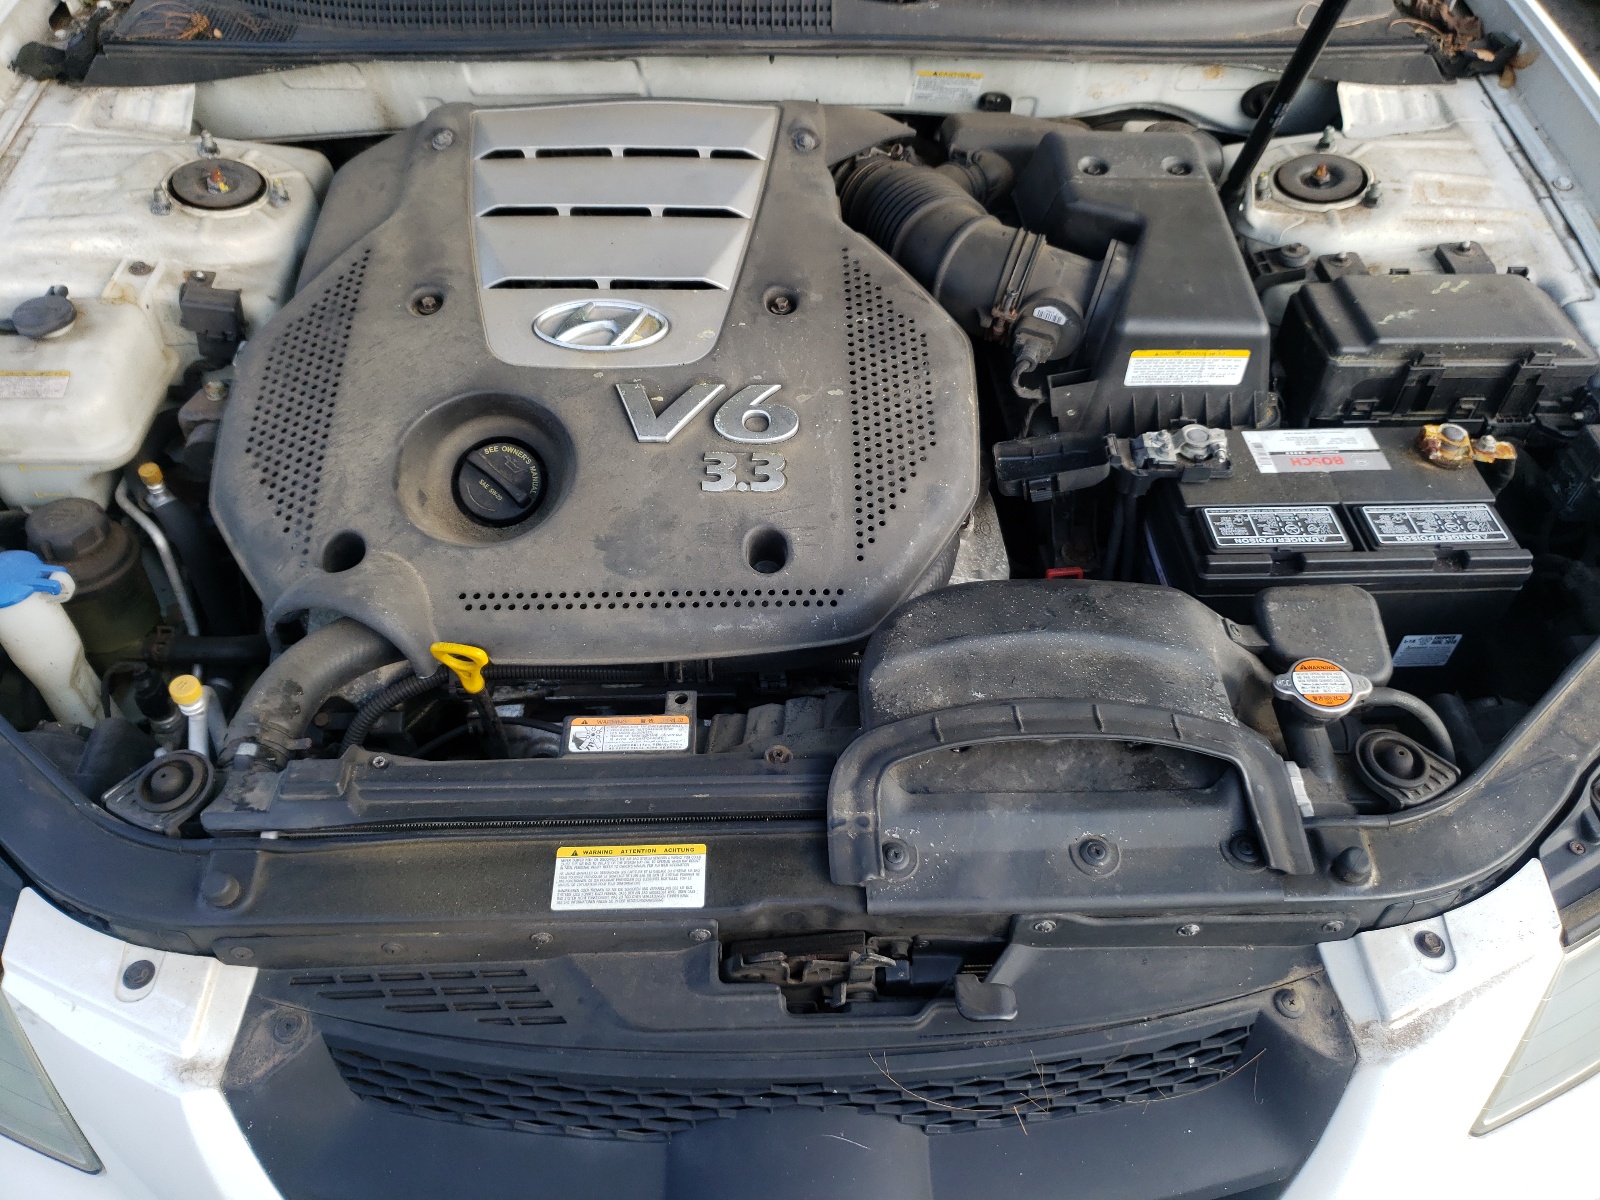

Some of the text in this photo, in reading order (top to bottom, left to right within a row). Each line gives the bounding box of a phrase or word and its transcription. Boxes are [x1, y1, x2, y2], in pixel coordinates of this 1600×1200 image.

[615, 383, 799, 444] V6
[1289, 456, 1344, 467] BOSCH
[484, 445, 539, 495] SEE OWNER'S MANUAL
[700, 451, 787, 493] 3.3
[478, 478, 490, 490] SAE
[1234, 536, 1319, 545] DANGER/POISON
[1396, 534, 1480, 543] DANGER/POISON
[1276, 679, 1292, 687] HCC
